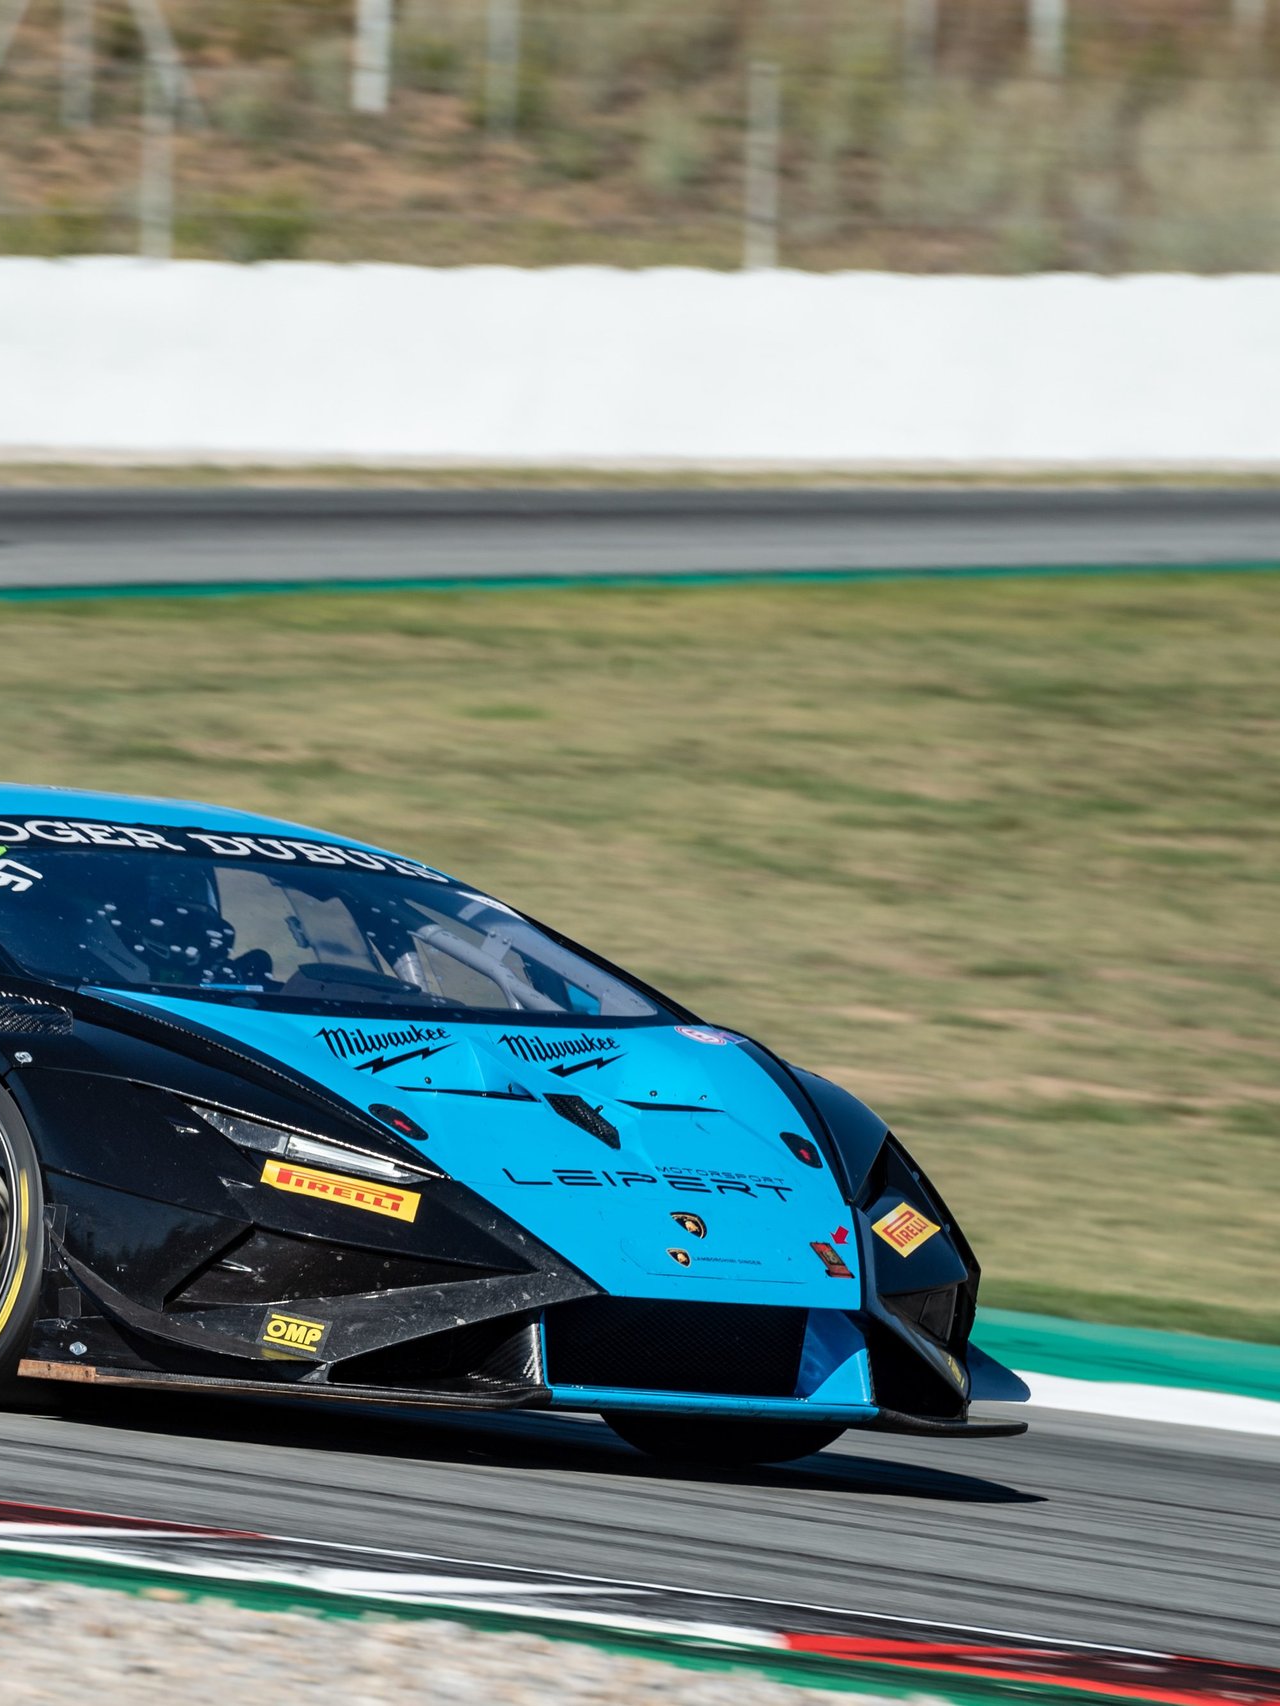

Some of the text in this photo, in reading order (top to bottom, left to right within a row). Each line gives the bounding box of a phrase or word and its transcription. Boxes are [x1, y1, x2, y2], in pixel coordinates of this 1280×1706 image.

[187, 833, 449, 884] DUBUIS
[313, 1024, 451, 1060] Milwaukee
[497, 1033, 621, 1064] Milwaukee
[276, 1167, 405, 1212] PIRELLI
[502, 1167, 793, 1202] LEIPERT
[655, 1166, 784, 1184] MOTORSPORT
[882, 1210, 929, 1248] PIRELLI
[267, 1320, 322, 1346] OMP
